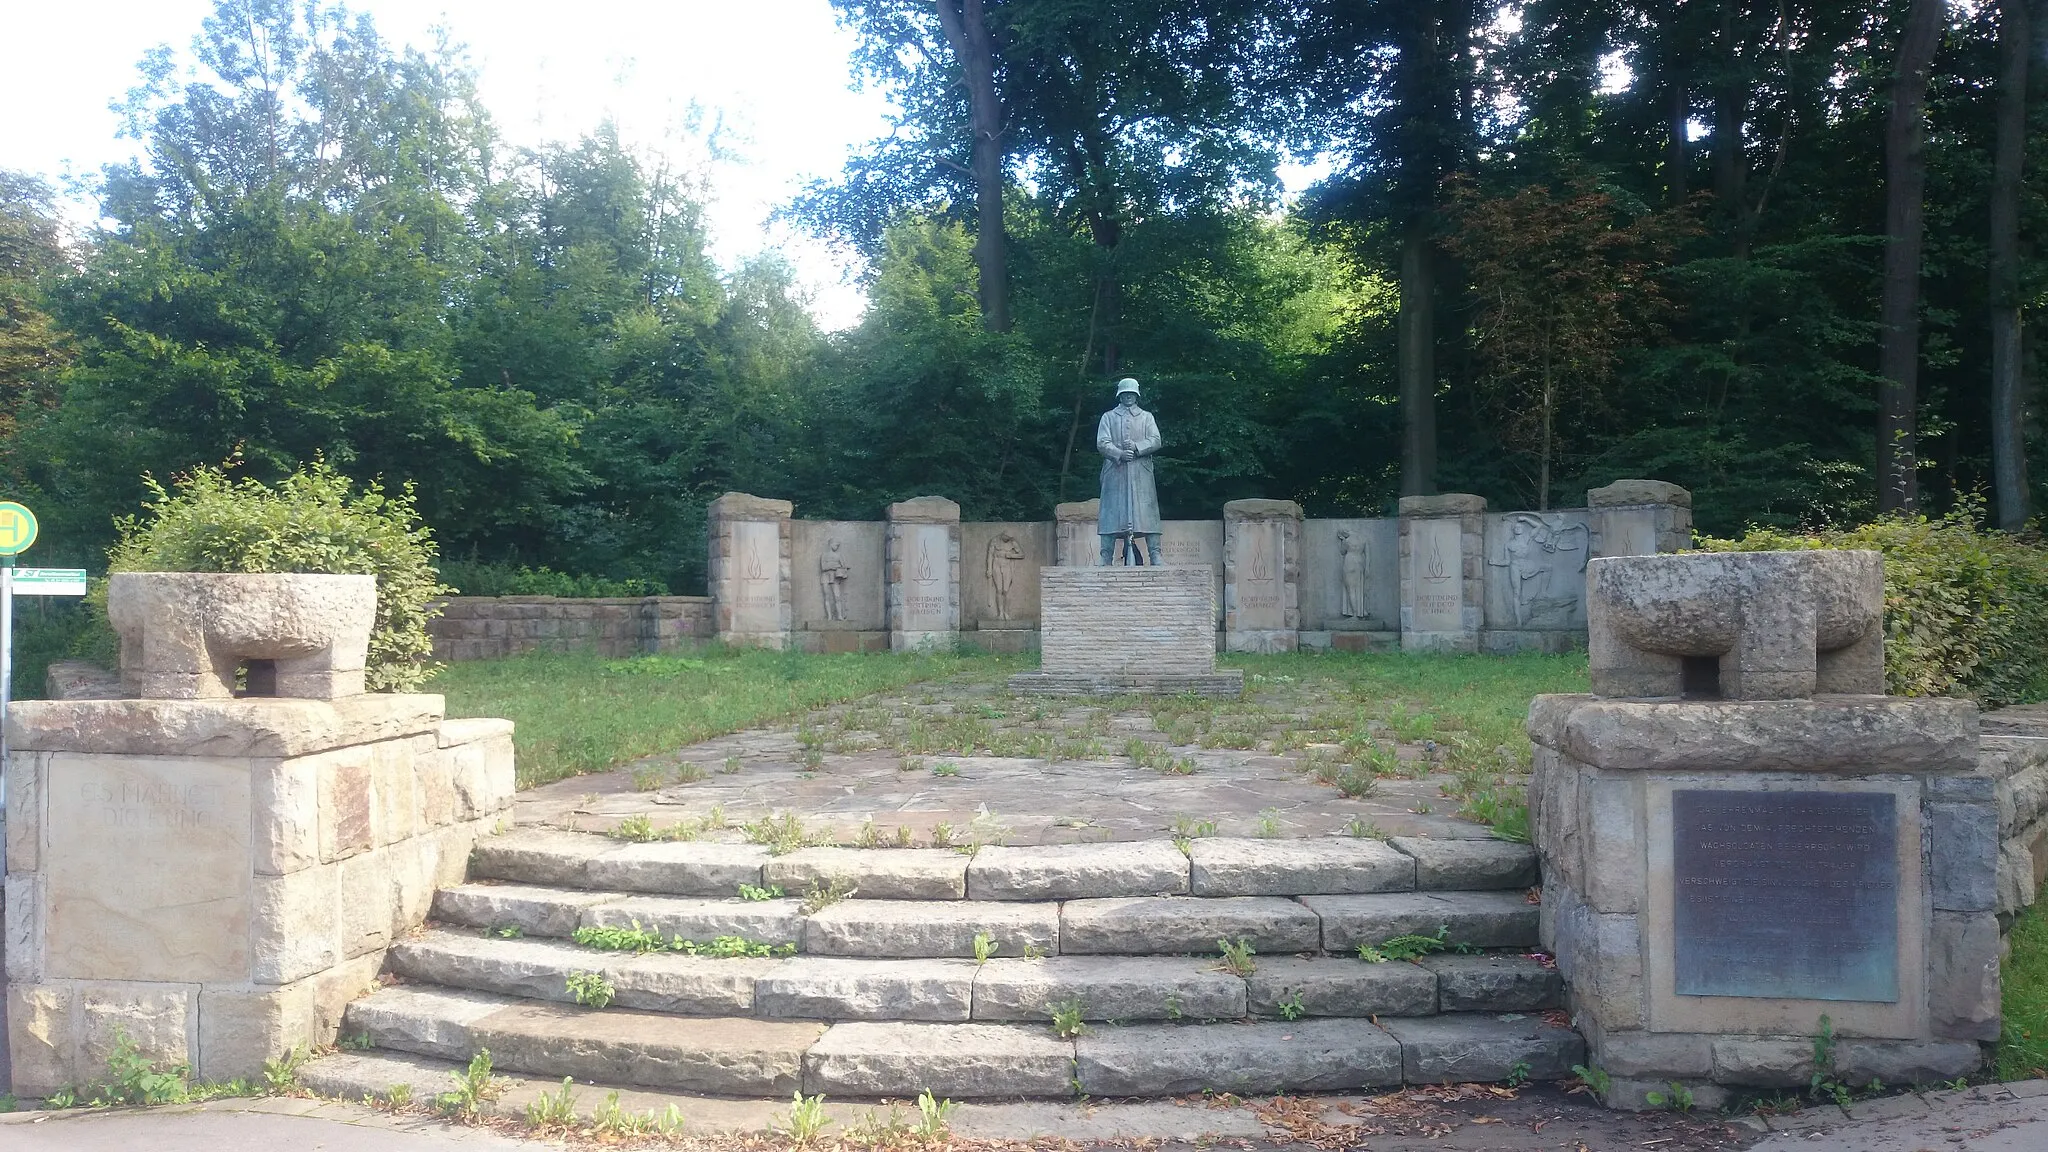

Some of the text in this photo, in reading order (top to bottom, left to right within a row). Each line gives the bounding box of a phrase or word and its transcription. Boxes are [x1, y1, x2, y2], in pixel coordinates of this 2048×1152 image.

[1721, 806, 1774, 815] EHRENMAL
[1699, 841, 1773, 850] WACHSOLDATEN
[1679, 877, 1740, 886] VERSCHWEIGT
